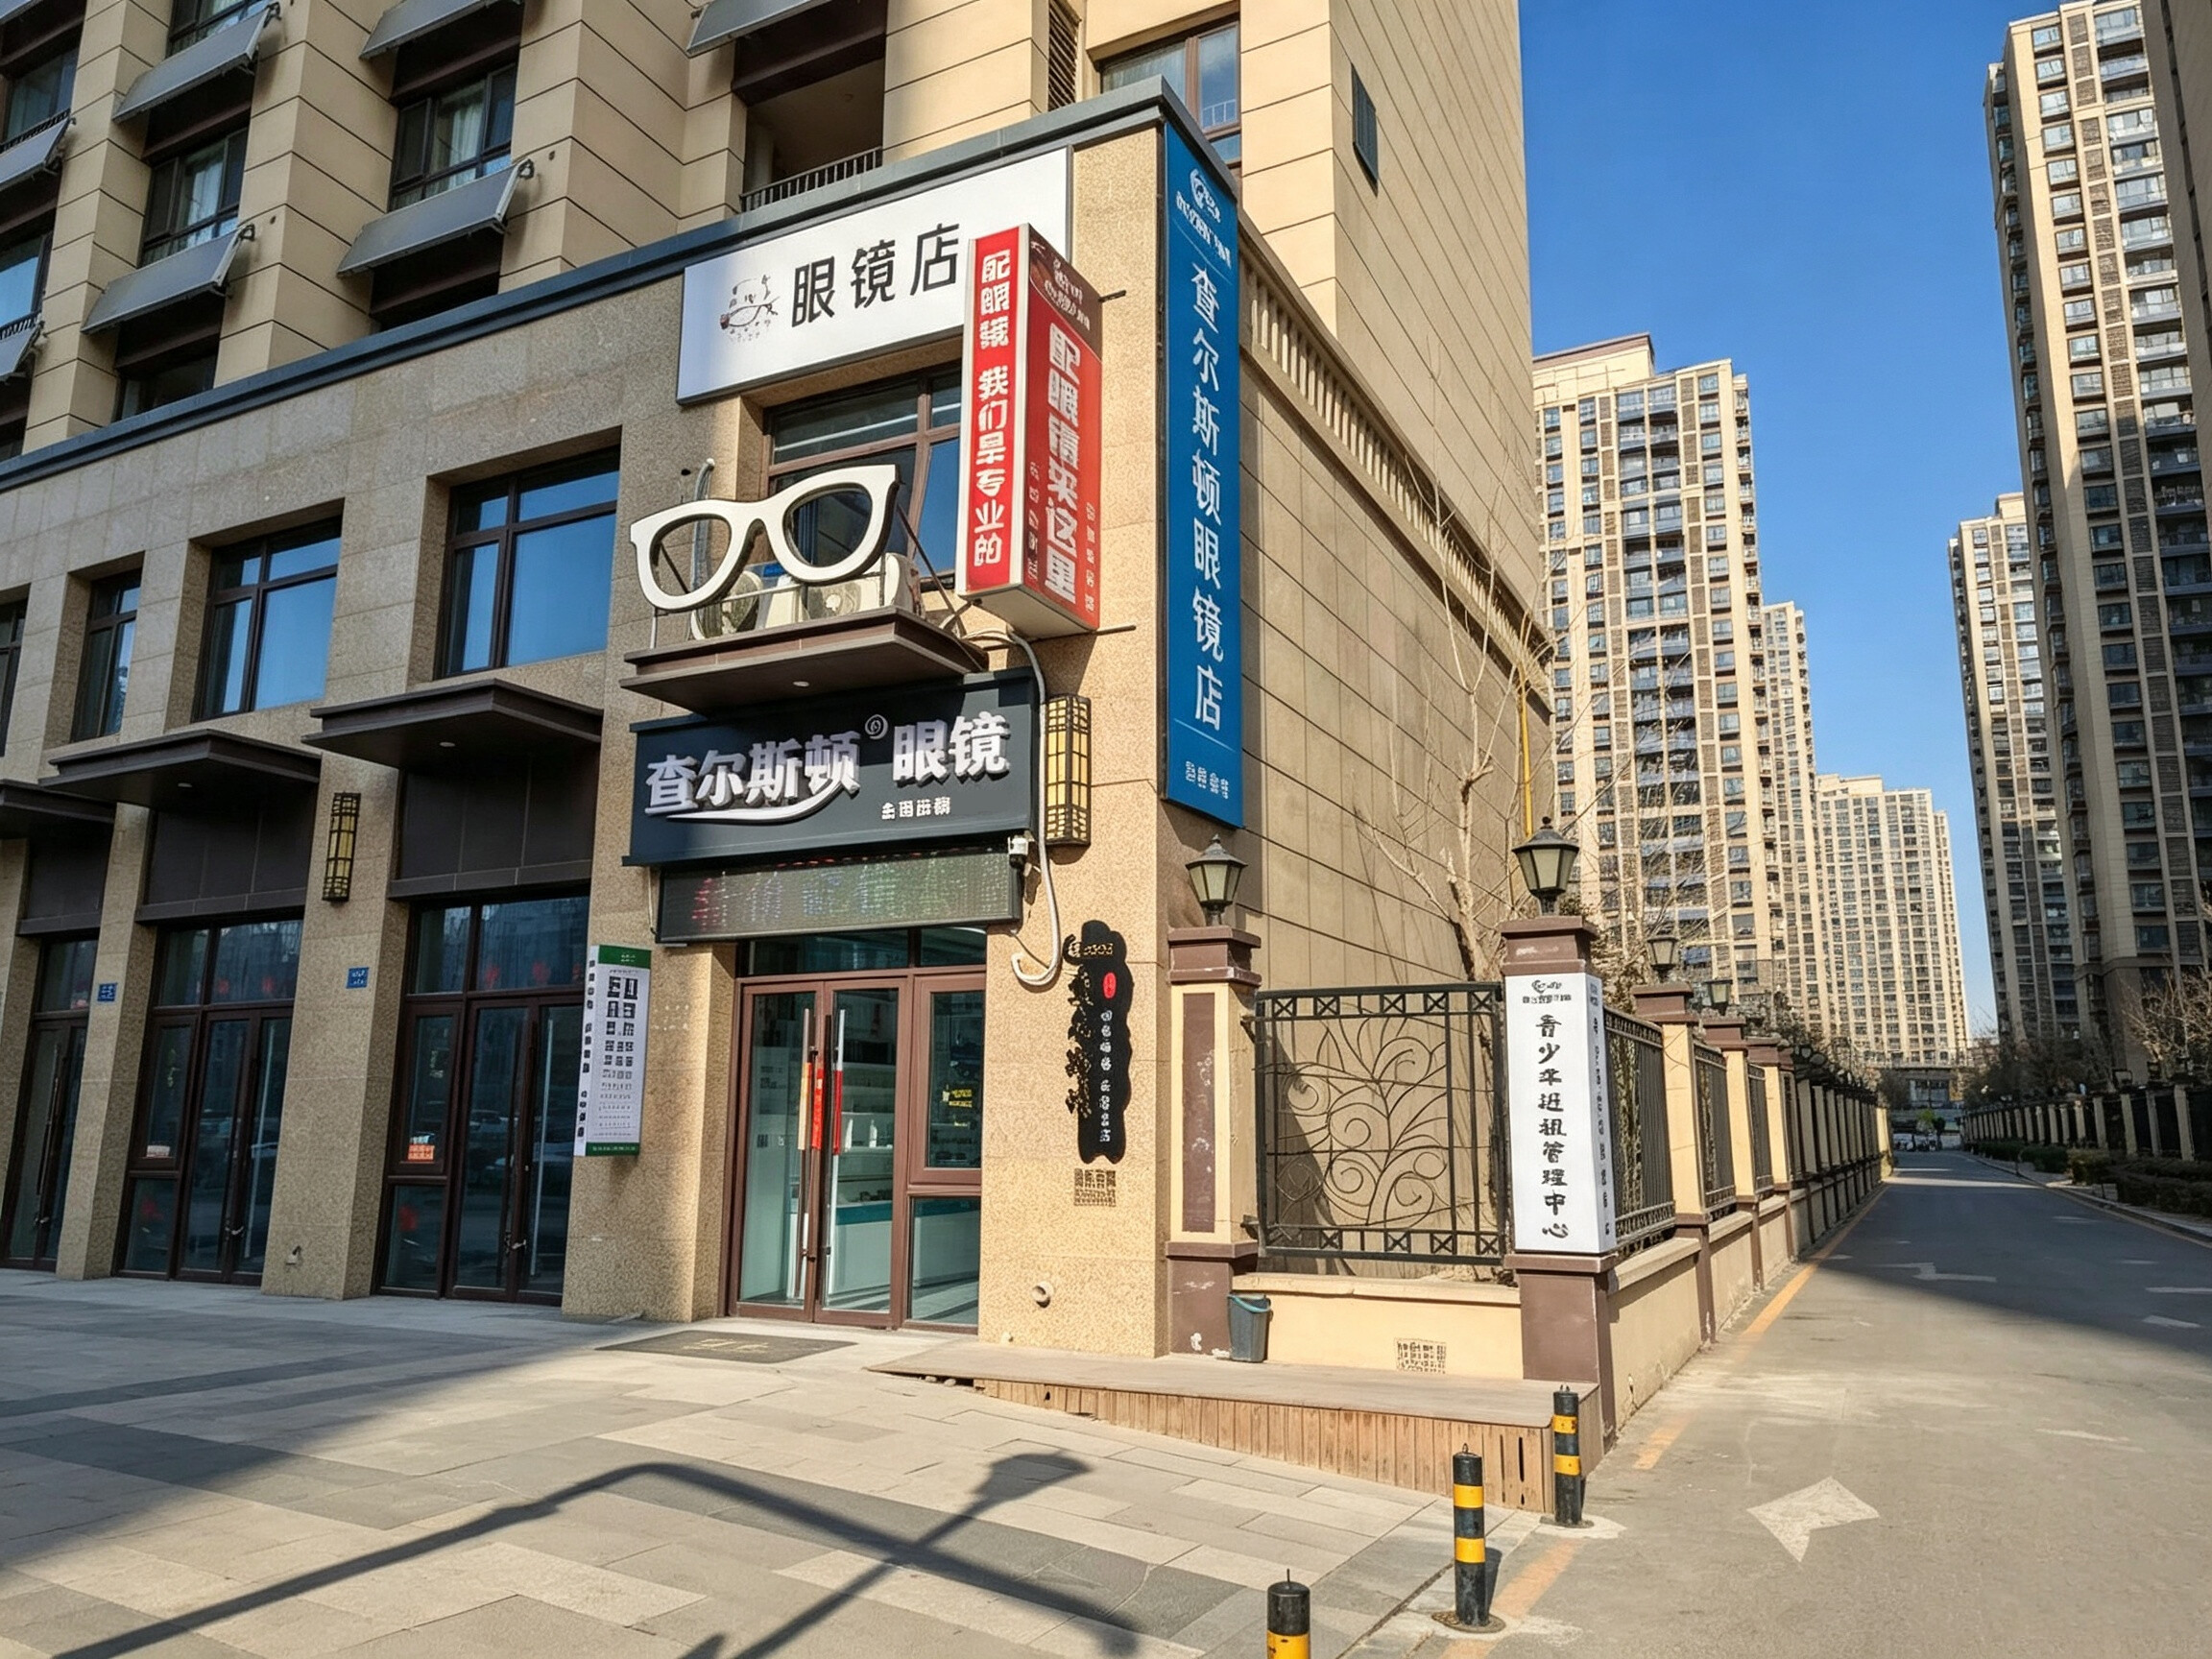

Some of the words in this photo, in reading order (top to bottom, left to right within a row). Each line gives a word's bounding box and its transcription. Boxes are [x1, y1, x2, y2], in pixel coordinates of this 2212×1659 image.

[790, 223, 960, 328] 眼镜店
[1190, 261, 1224, 732] 查尔斯顿眼镜店
[644, 730, 862, 818] 查尔斯顿
[893, 710, 1011, 787] 眼镜
